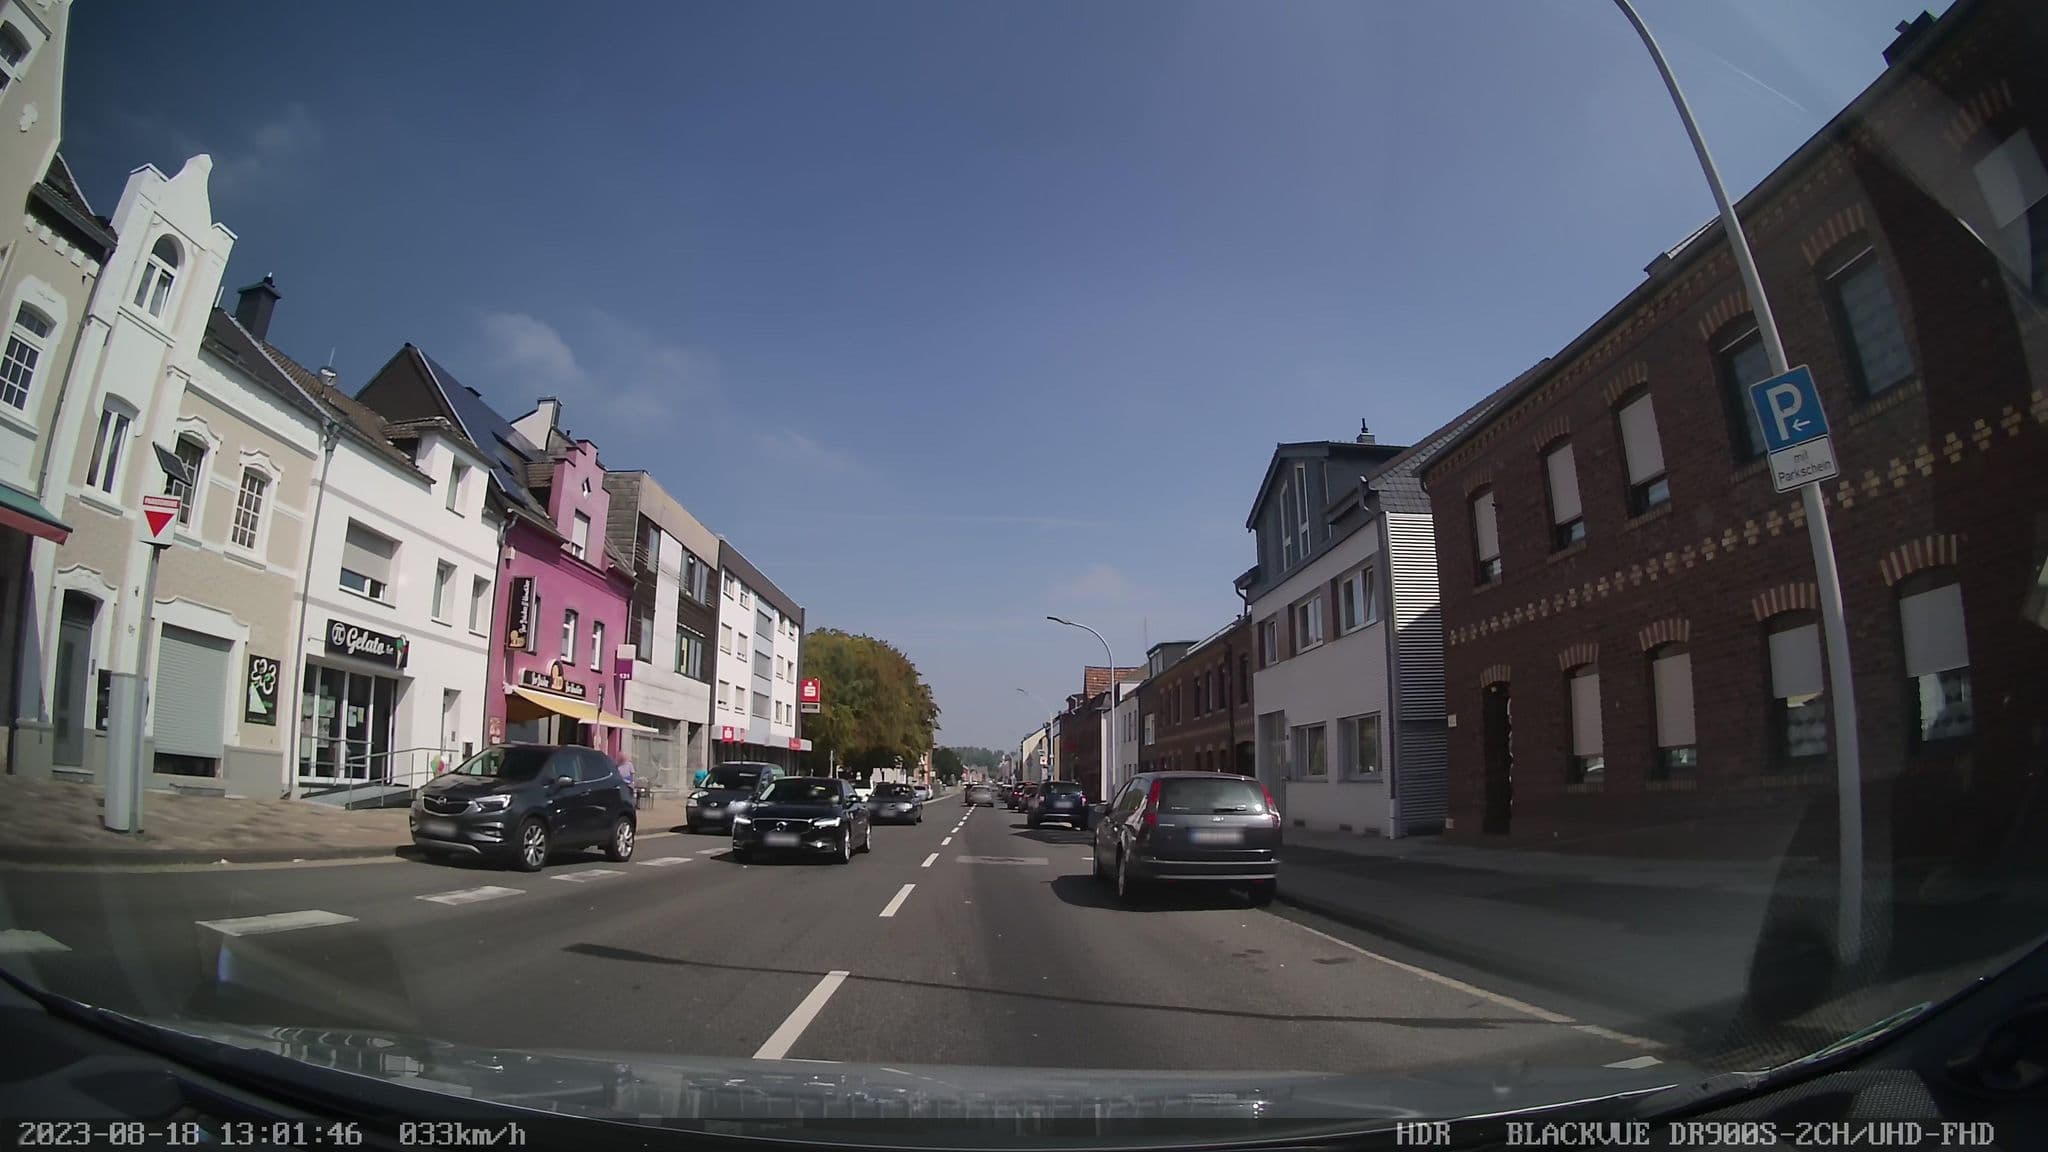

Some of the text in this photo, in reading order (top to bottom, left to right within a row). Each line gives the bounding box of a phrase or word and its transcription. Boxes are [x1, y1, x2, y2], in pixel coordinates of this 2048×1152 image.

[1766, 383, 1802, 441] P
[1794, 449, 1809, 463] mit
[1777, 460, 1832, 483] Parkschein
[346, 627, 385, 655] Gelato
